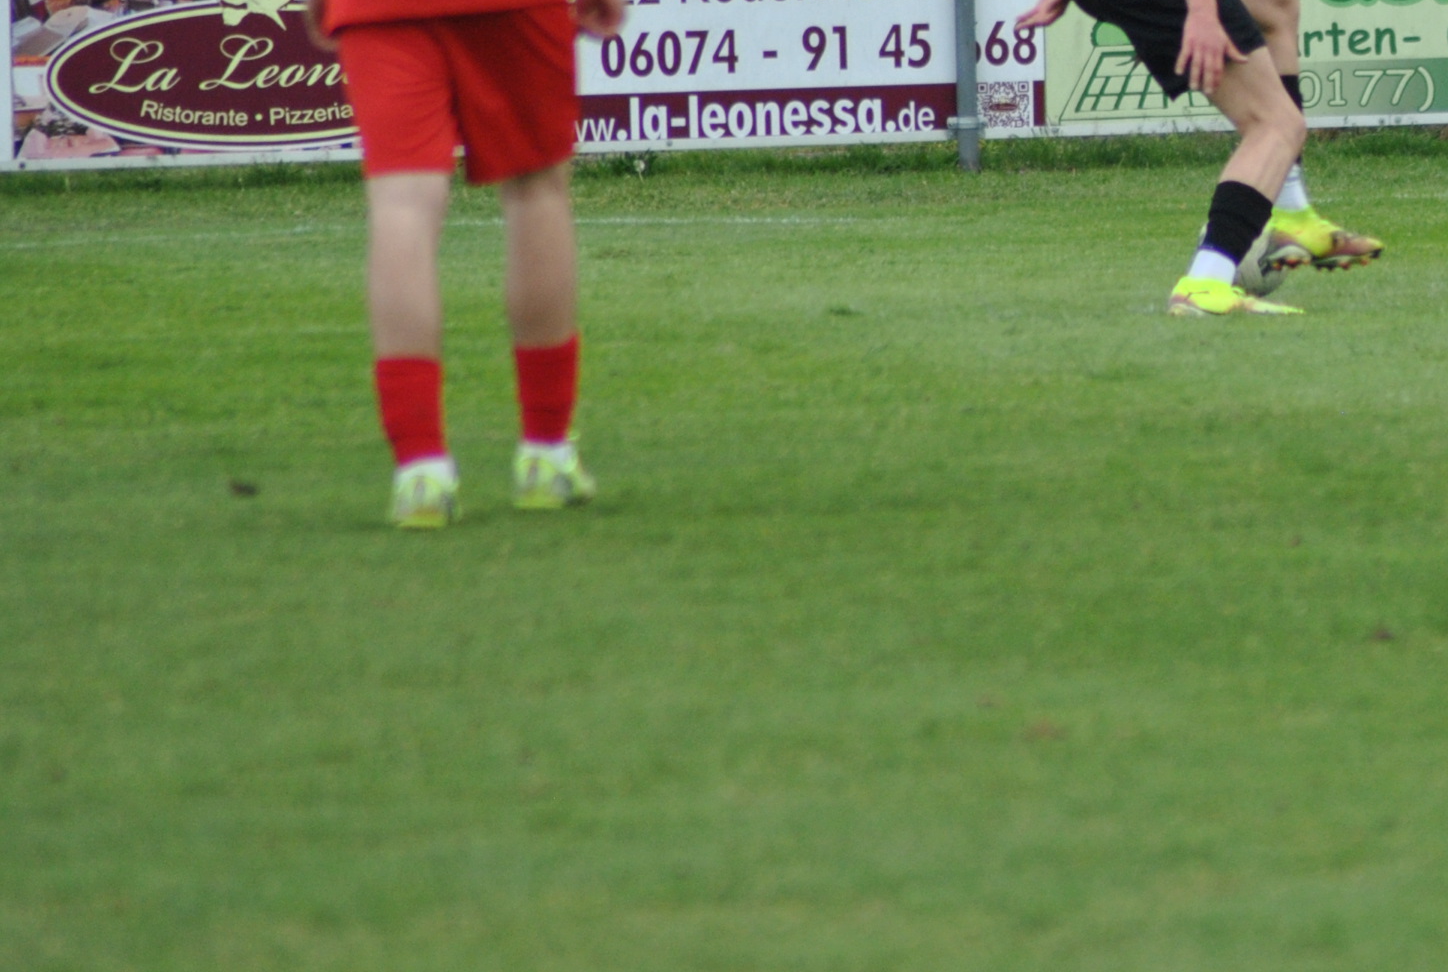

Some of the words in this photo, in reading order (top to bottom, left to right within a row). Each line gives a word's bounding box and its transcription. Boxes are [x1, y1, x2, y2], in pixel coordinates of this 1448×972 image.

[601, 28, 739, 78] 06074
[802, 25, 849, 72] 91
[878, 22, 933, 70] 45
[975, 20, 1038, 67] 68
[1297, 21, 1421, 58] rten-
[88, 37, 181, 94] La
[198, 34, 348, 91] Leon
[140, 99, 249, 127] Ristorante
[269, 103, 354, 126] Pizzeria
[1298, 65, 1436, 113] 0177)
[574, 94, 937, 142] w.la-leonessa.de
